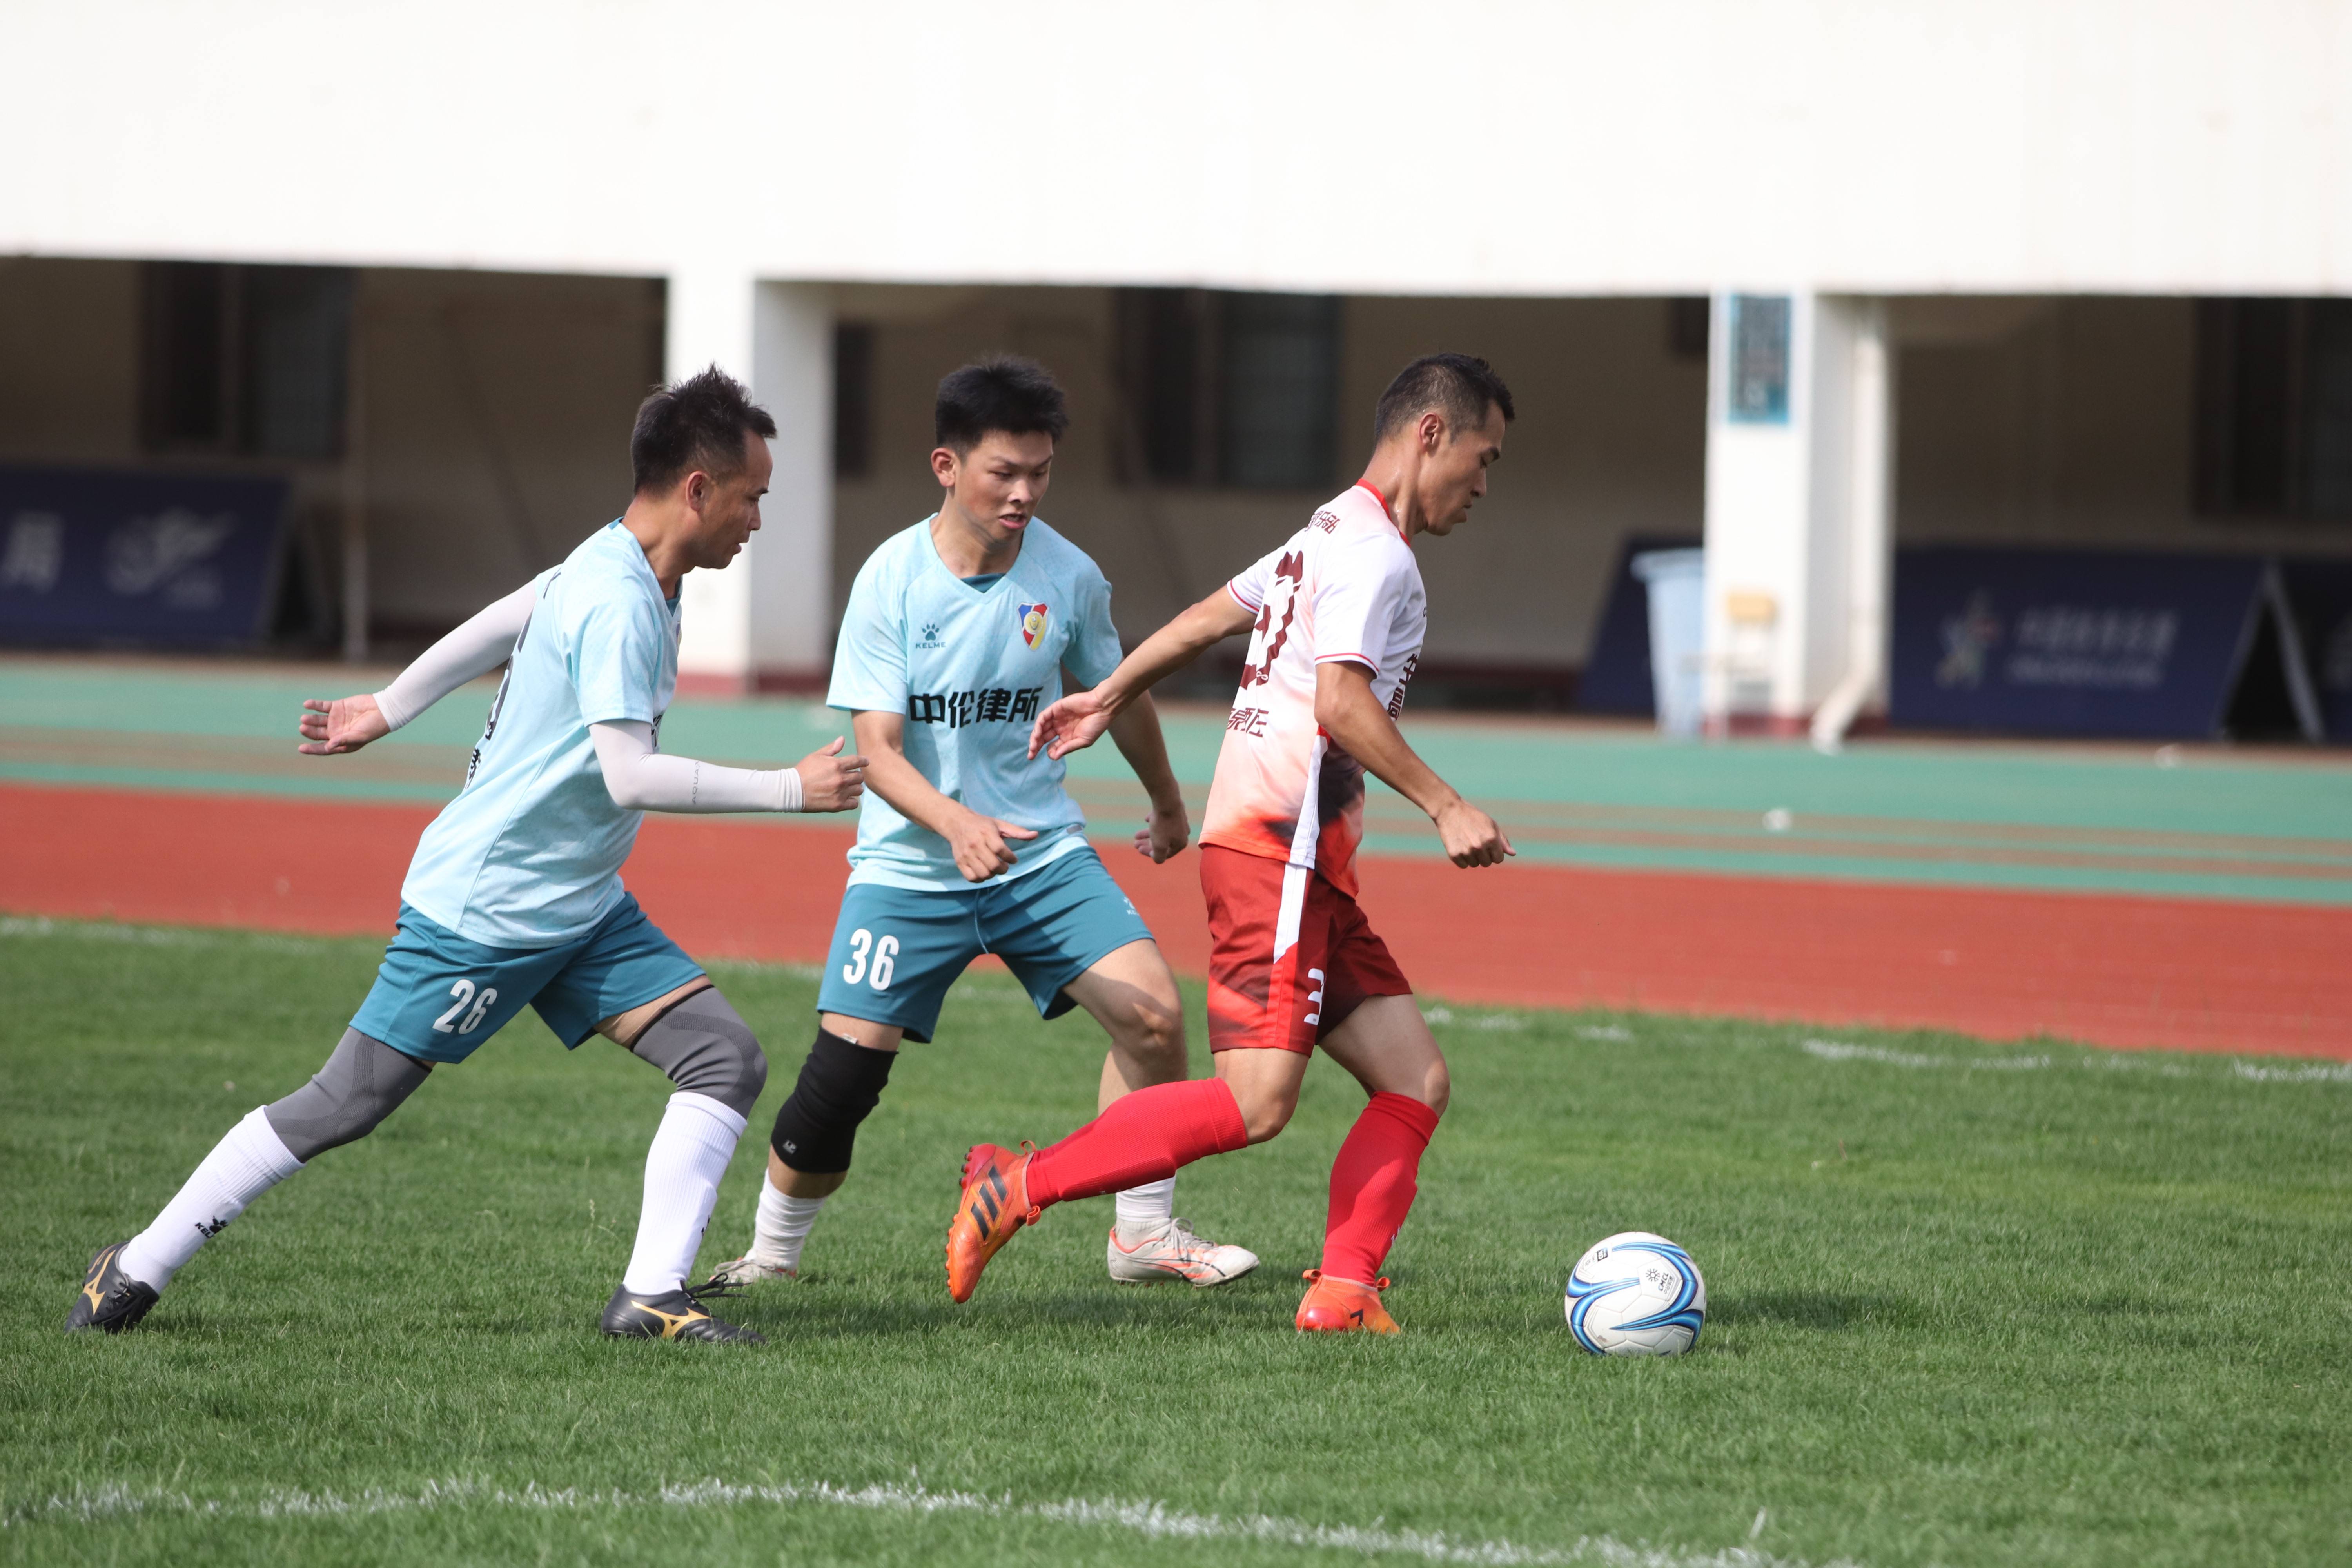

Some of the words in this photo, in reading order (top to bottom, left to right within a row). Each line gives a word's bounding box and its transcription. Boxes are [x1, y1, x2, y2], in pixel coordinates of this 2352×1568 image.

[909, 686, 1044, 728] 中伦律所
[843, 928, 900, 991] 36
[432, 979, 498, 1035] 26
[1658, 1272, 1668, 1291] CMCL
